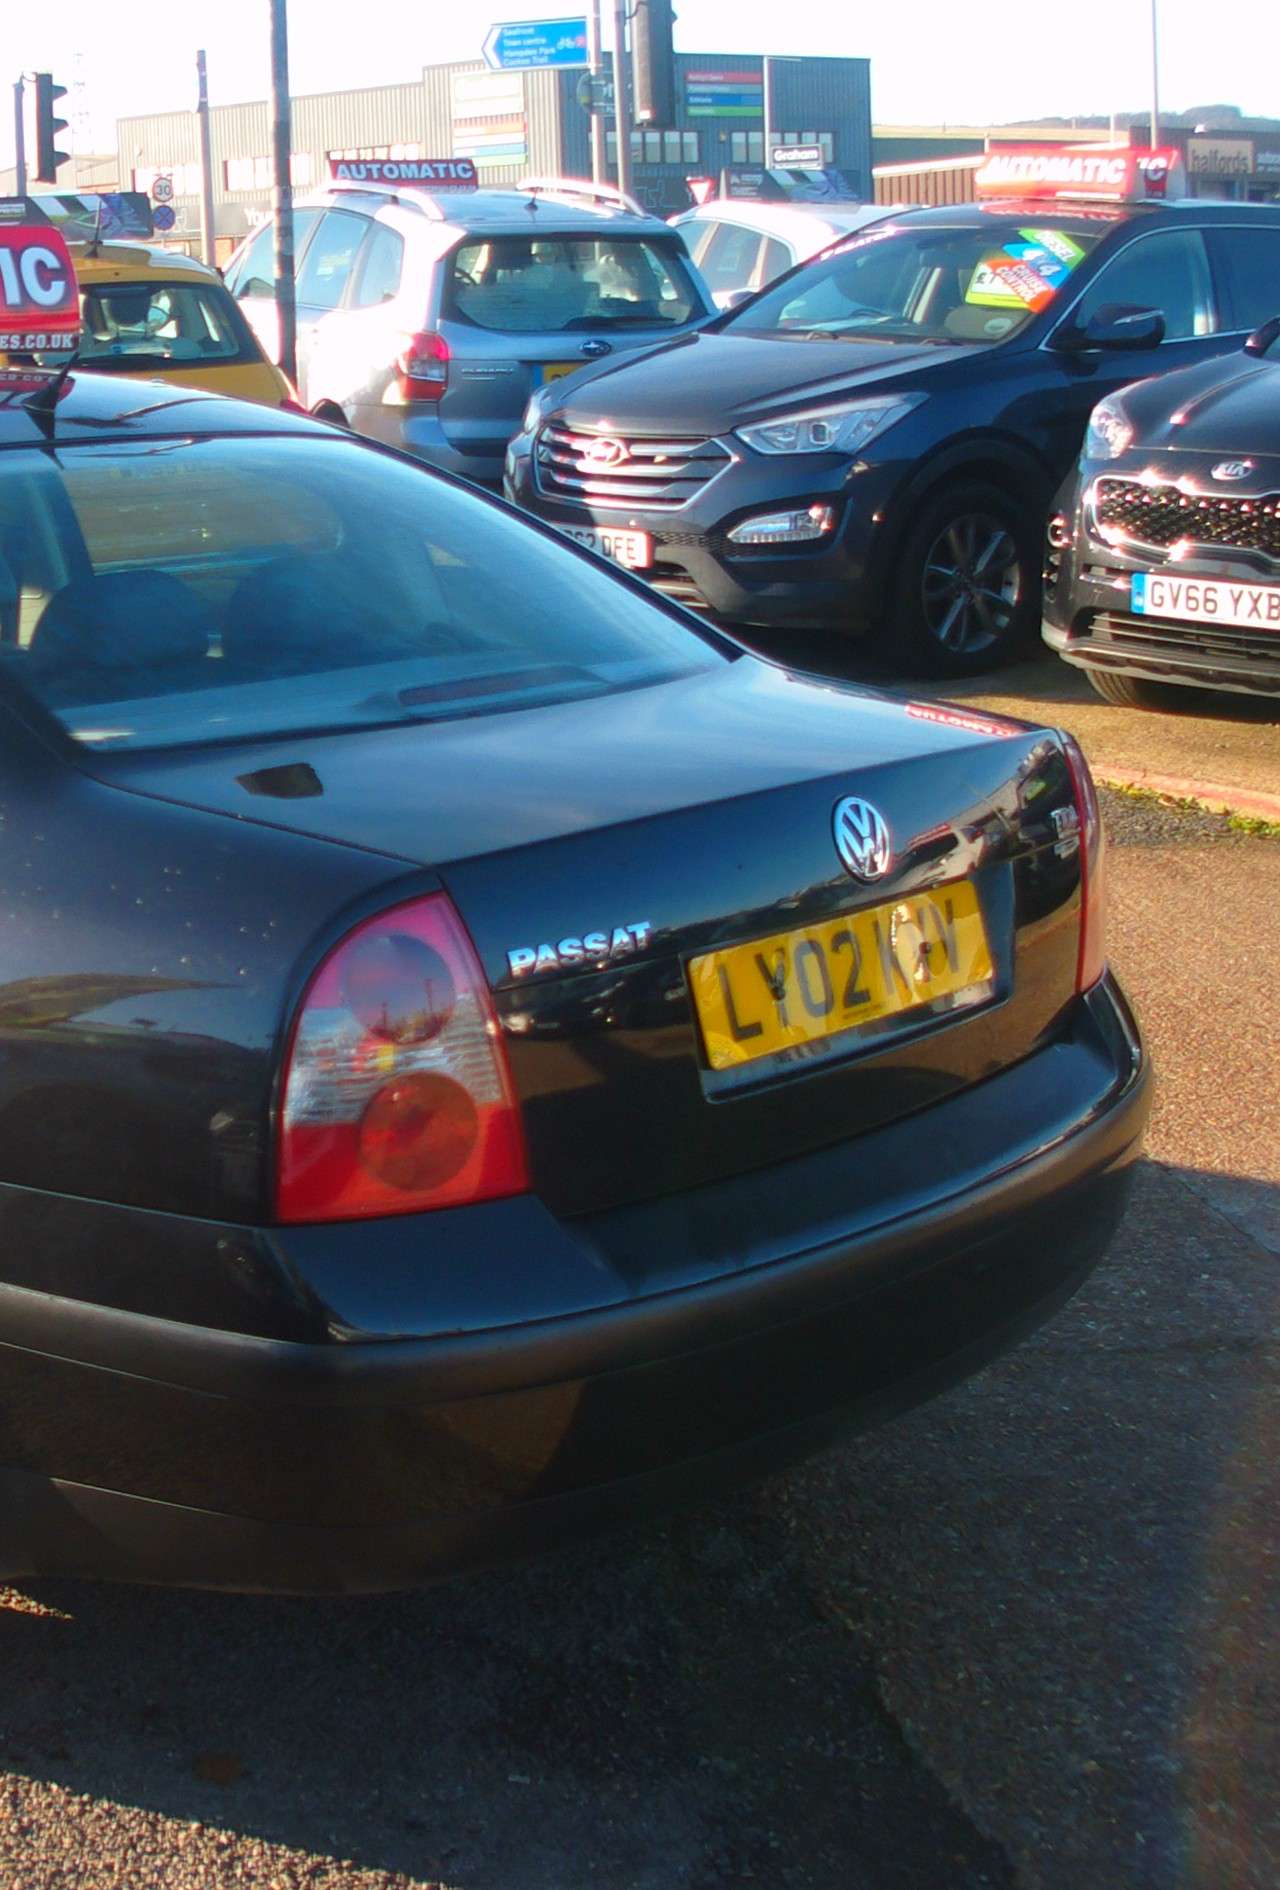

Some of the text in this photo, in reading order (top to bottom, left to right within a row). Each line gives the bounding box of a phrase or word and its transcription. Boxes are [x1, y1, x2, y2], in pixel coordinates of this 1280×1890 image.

[774, 149, 818, 162] Graham
[1191, 148, 1249, 173] halfords
[336, 162, 473, 180] AUTOMATIC
[976, 155, 1126, 184] AUTOMATIC
[157, 184, 170, 196] 30
[1217, 462, 1245, 477] KIA
[1151, 580, 1280, 622] GV66 YXB
[507, 920, 651, 978] PASSAT
[720, 928, 872, 1042] LY02
